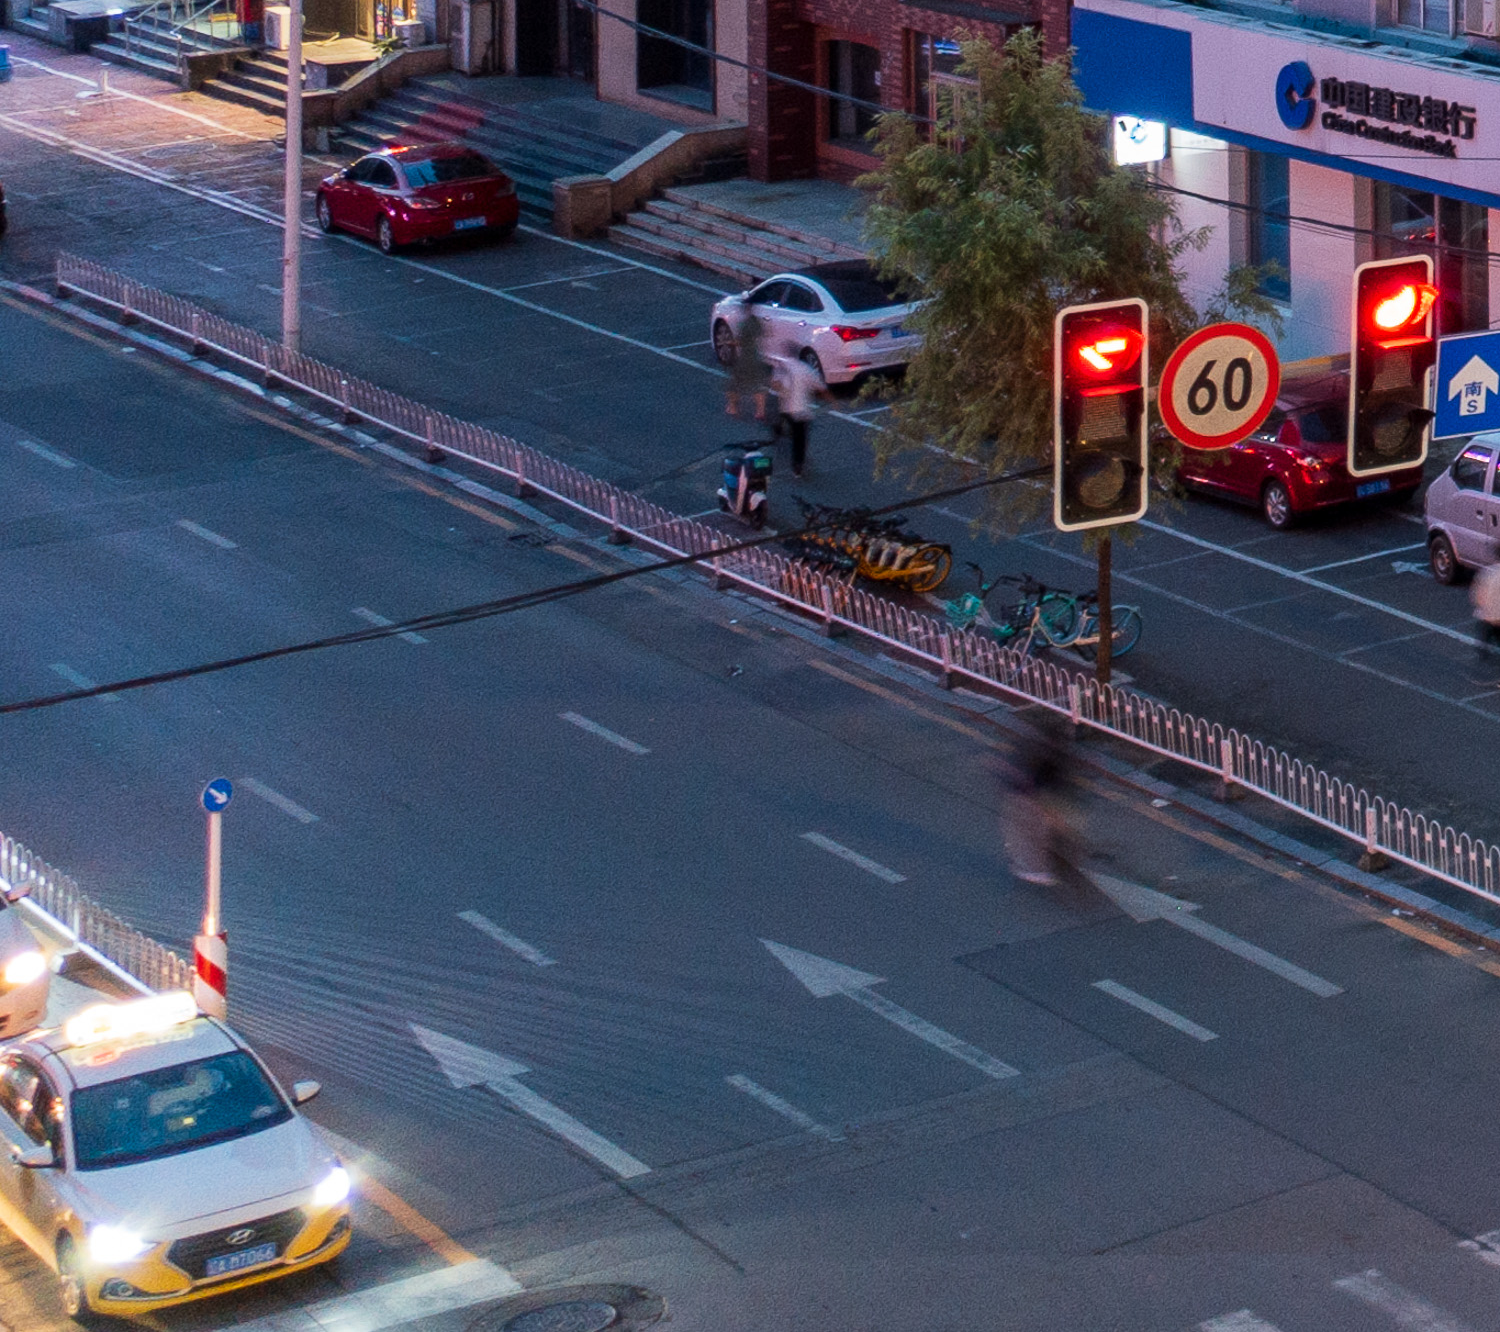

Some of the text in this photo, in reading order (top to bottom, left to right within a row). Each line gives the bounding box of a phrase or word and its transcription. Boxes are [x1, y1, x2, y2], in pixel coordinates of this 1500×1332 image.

[1320, 76, 1477, 140] 中国建设银行
[1187, 357, 1253, 416] 60
[1464, 381, 1482, 398] 南
[1466, 399, 1478, 413] S
